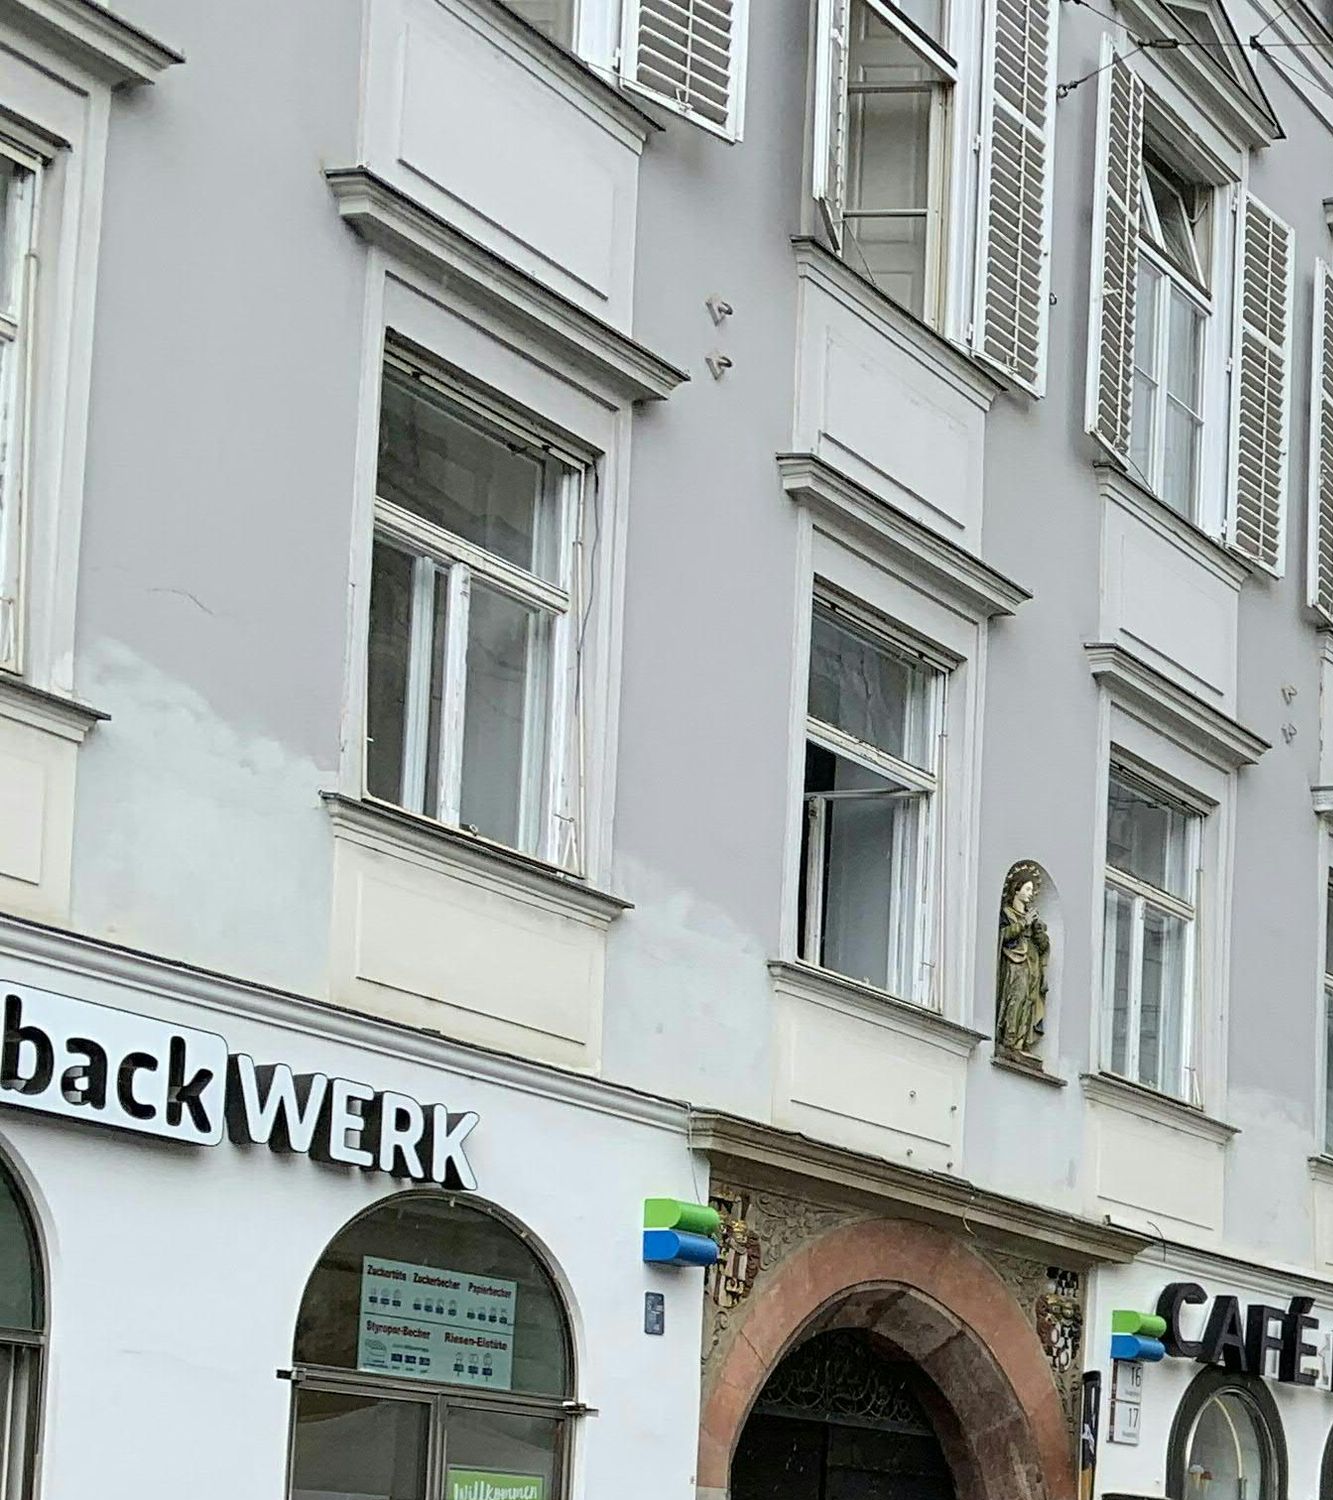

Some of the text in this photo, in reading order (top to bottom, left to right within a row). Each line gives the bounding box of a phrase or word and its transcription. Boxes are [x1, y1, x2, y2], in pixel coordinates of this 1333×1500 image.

[413, 1272, 461, 1290] Zuckerbecher
[1156, 1282, 1319, 1387] CAFÉ
[1131, 1367, 1142, 1387] 16
[1128, 1408, 1139, 1428] 17
